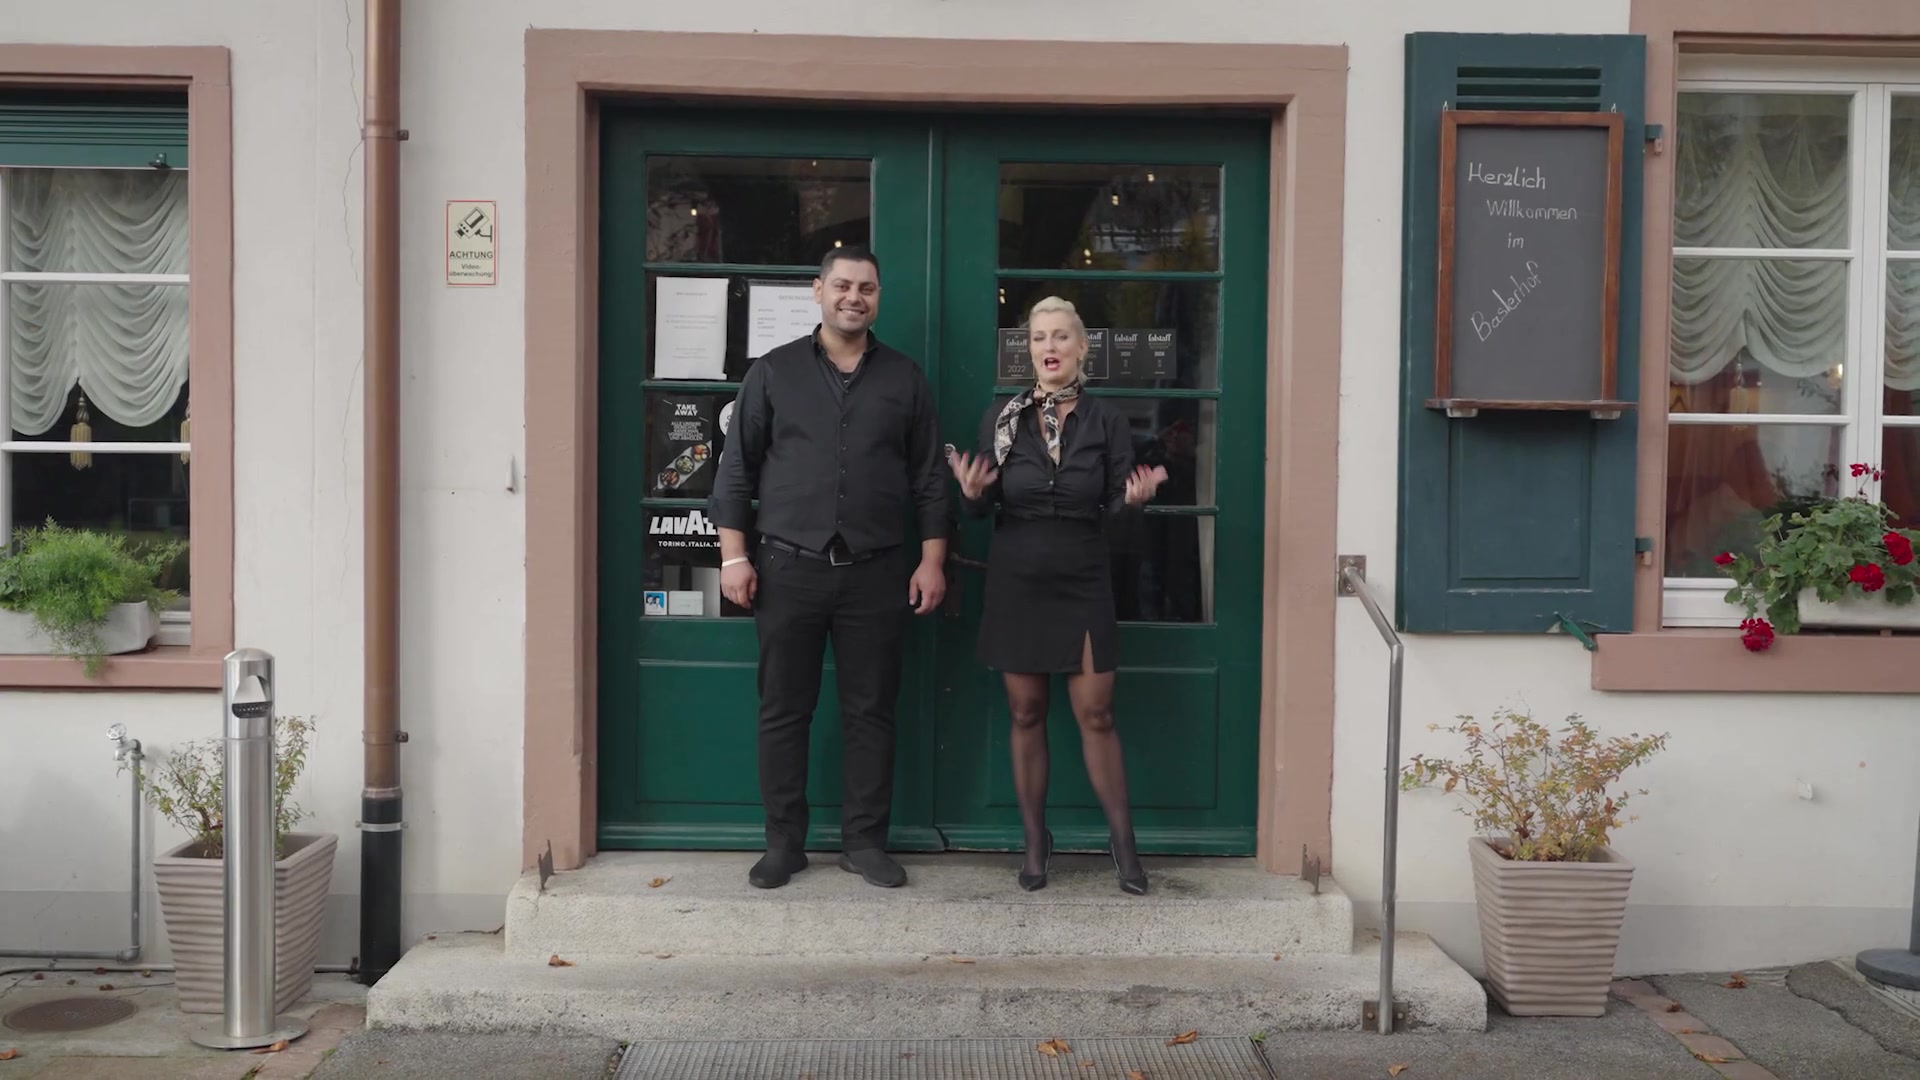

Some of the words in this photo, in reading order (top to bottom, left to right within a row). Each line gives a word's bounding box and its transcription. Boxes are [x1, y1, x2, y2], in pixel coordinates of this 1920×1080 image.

[1468, 162, 1547, 190] Herzlich
[1486, 199, 1578, 220] Willkommen
[1507, 232, 1525, 249] im
[449, 250, 494, 259] ACHTUNG
[1470, 259, 1542, 342] Baslerhof
[1114, 333, 1138, 342] falstaff
[1148, 333, 1172, 342] falstaff
[1007, 364, 1026, 373] 2022
[649, 510, 718, 535] LAVAZ
